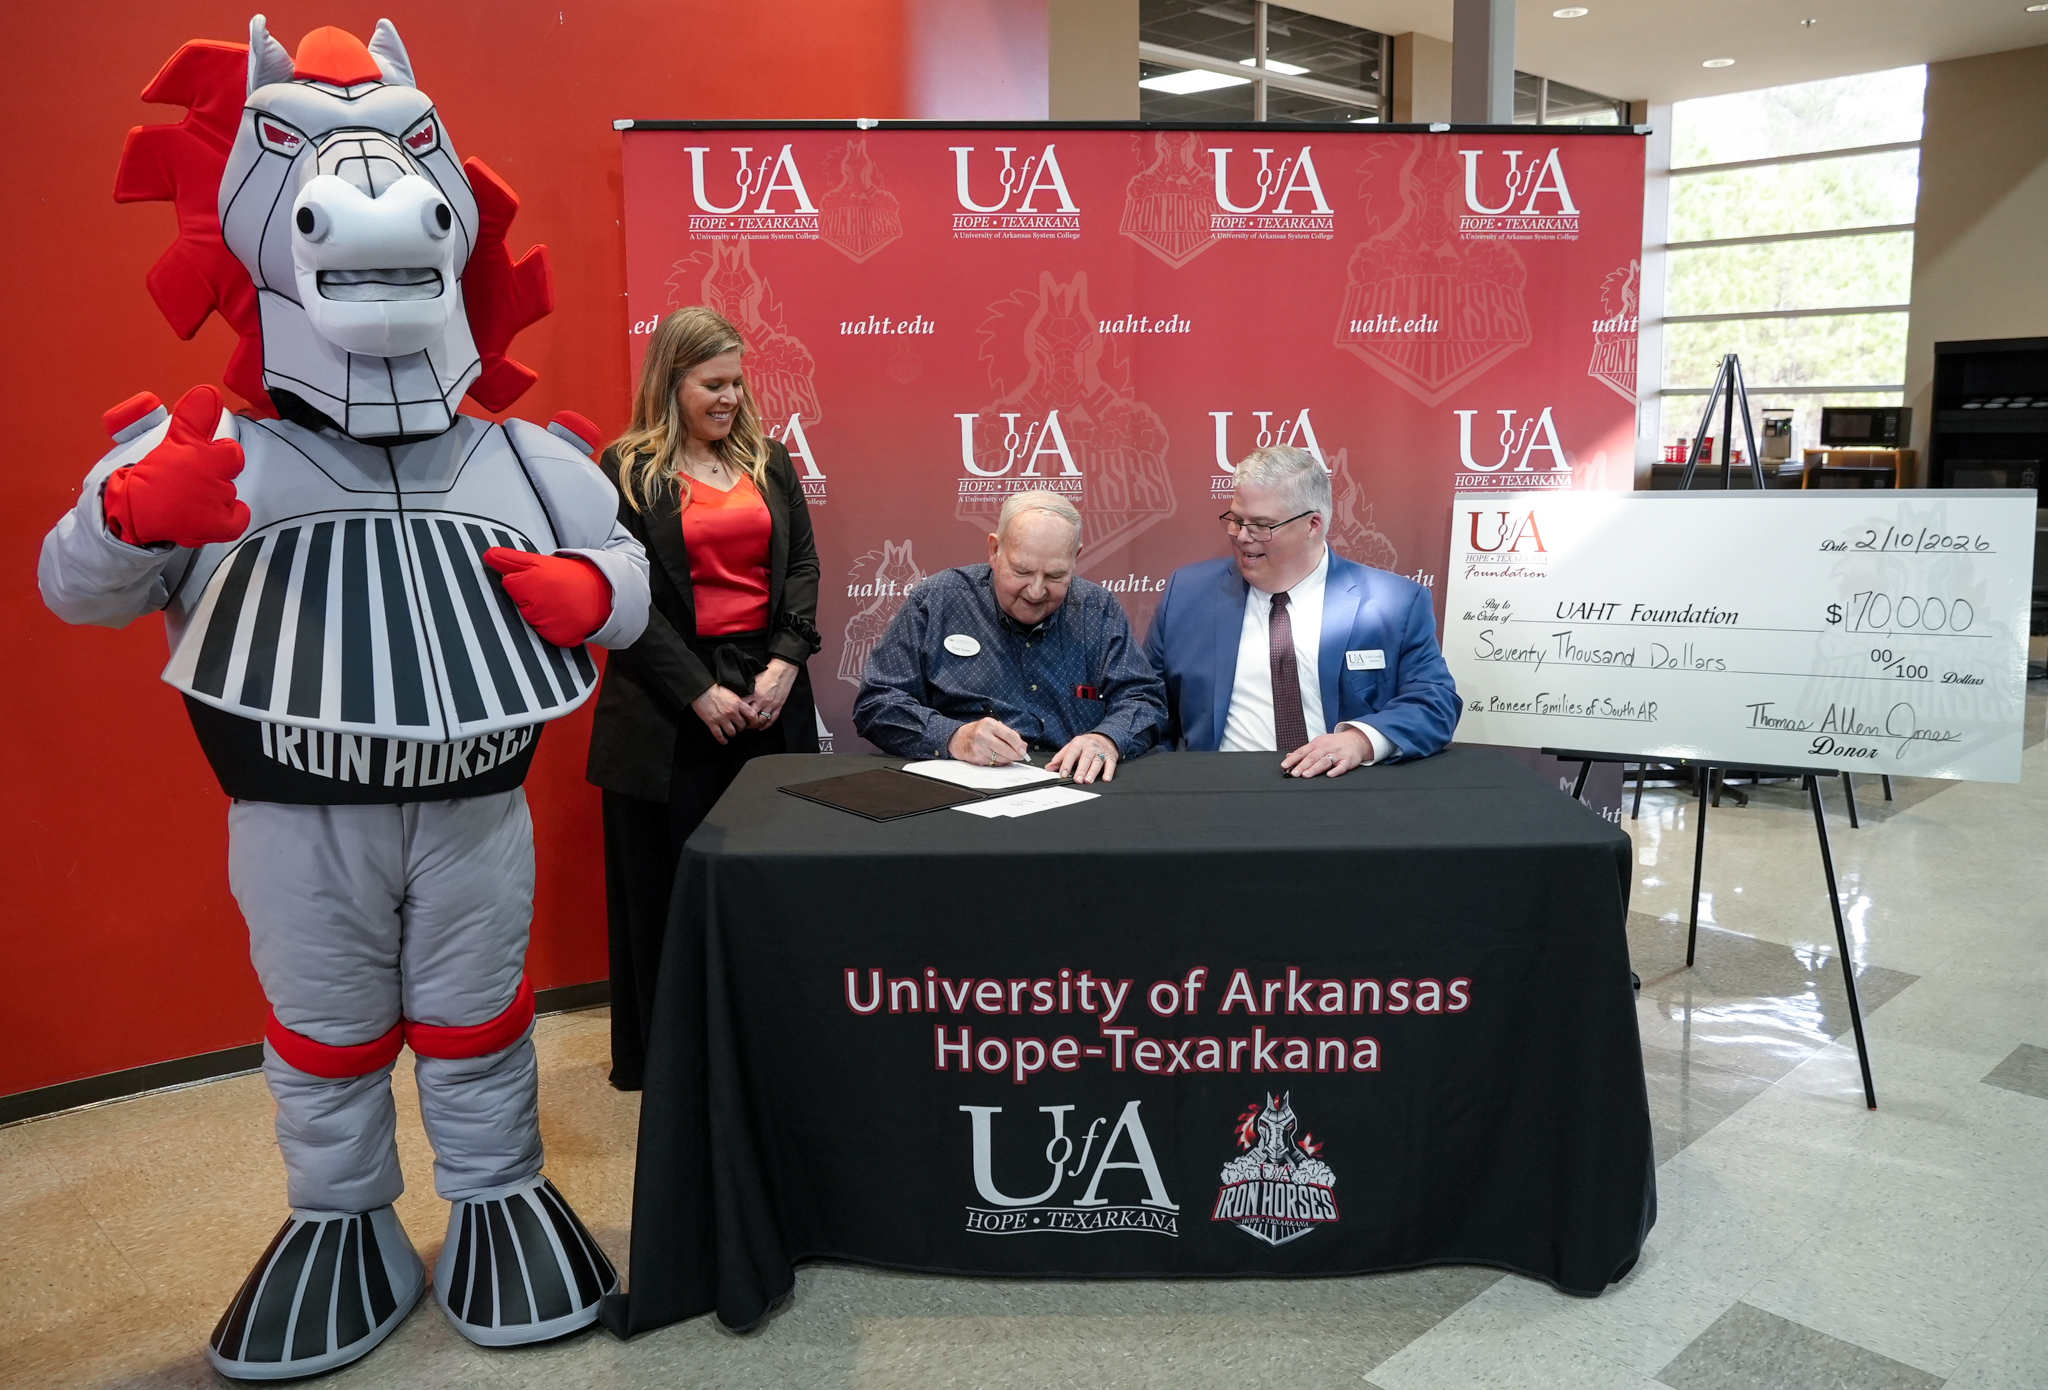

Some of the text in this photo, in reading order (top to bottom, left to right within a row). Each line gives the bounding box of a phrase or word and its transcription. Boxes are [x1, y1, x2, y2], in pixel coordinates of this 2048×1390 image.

[688, 217, 819, 229] HOPE TEXARKANA
[953, 216, 1080, 228] HOPE TEXARKANA
[1210, 217, 1334, 229] HOPE TEXARKANA
[1459, 218, 1579, 230] HOPE TEXARKANA
[696, 233, 729, 241] University
[796, 233, 819, 241] College
[960, 232, 992, 240] University
[1057, 232, 1080, 240] College
[1217, 233, 1249, 241] University
[1311, 233, 1334, 241] College
[1466, 234, 1496, 242] University
[1557, 234, 1579, 242] College
[840, 315, 935, 335] uaht.edu
[1099, 314, 1191, 333] uaht.edu
[1350, 313, 1439, 333] uaht.edu
[1592, 314, 1639, 333] uaht
[958, 480, 1083, 492] HOPE TEXARKANA
[1454, 474, 1572, 487] HOPE TEXARKANA
[965, 496, 997, 504] University
[1819, 526, 1990, 554] Date 2/10/2026
[1465, 554, 1490, 562] HOPE
[1464, 564, 1547, 579] Foundation
[1462, 611, 1476, 621] the
[1476, 610, 1500, 622] Order
[1500, 612, 1513, 625] of
[1555, 601, 1622, 621] UAHT
[1630, 603, 1739, 625] Foundation
[1482, 598, 1511, 611] Pay to
[1474, 629, 1548, 673] Seventy
[1552, 630, 1636, 667] Thousand
[1650, 642, 1727, 671] Dollars
[1940, 671, 1986, 686] Dollars
[1468, 692, 1658, 722] For Pioneer Families of South AR
[1746, 702, 1962, 760] Thomas Allen Jones
[261, 720, 371, 785] IRON
[1808, 736, 1879, 759] Donor
[844, 966, 1472, 1023] University of Arkansas
[934, 1025, 1382, 1084] Hope-Texarkana
[1214, 1181, 1338, 1220] IRON HORSES
[966, 1210, 1178, 1234] HOPE TEXARKANA
[1241, 1217, 1310, 1228] HOPE TEXARKANA
